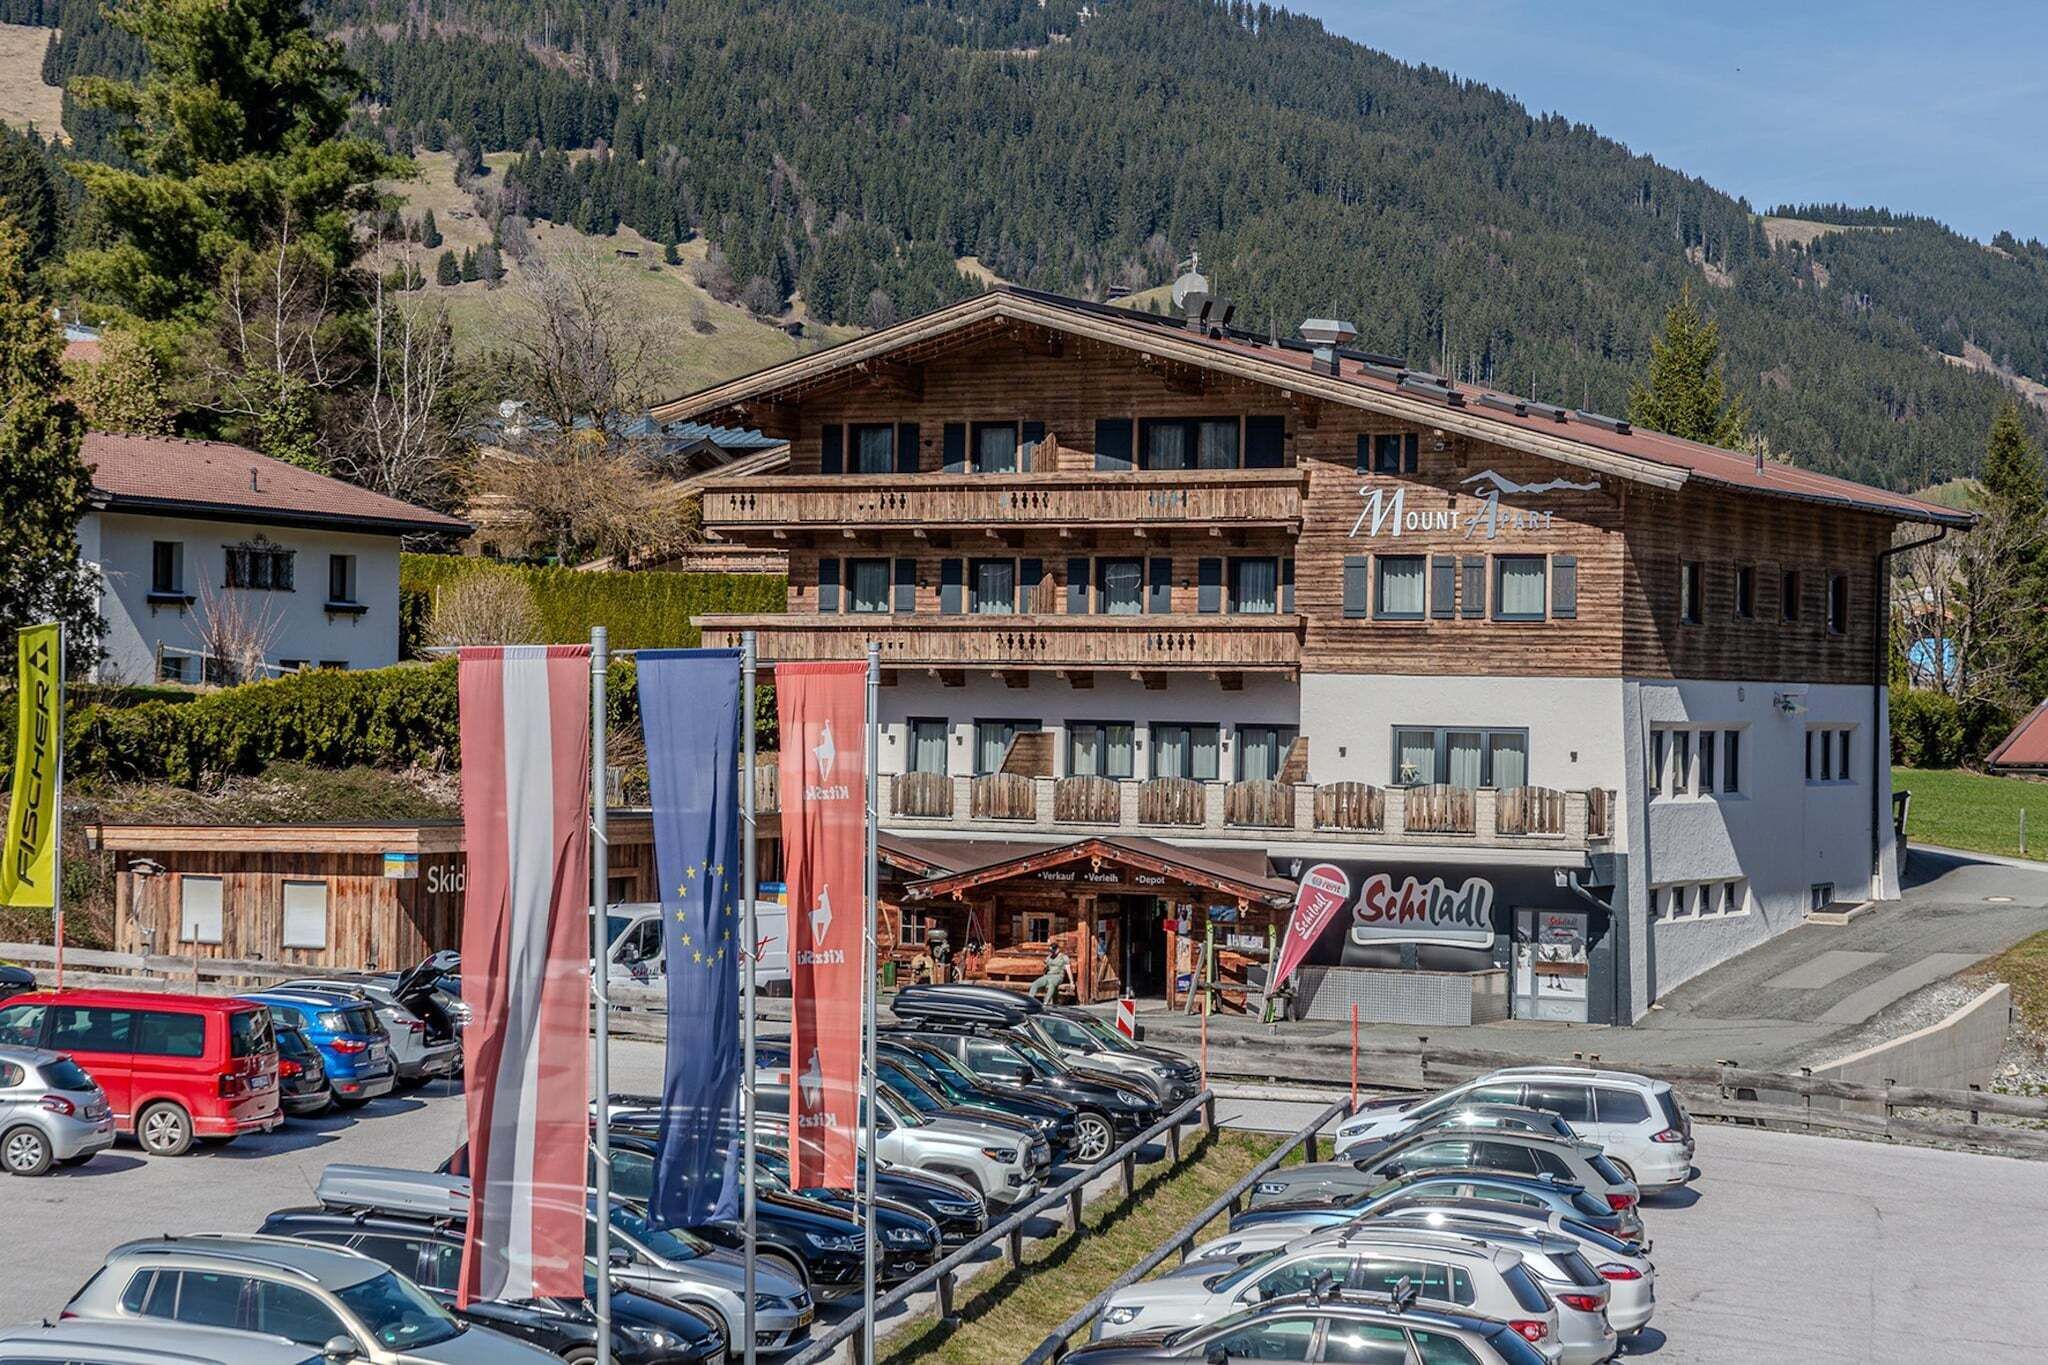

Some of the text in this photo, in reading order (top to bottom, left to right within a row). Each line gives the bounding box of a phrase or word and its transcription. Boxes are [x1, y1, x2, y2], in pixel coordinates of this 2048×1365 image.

[17, 680, 49, 888] FISCHER
[427, 864, 466, 894] Skid
[1042, 872, 1165, 885] Verkauf Verleih Depot
[1294, 891, 1329, 936] Schiladl
[1358, 880, 1486, 928] Schiladl
